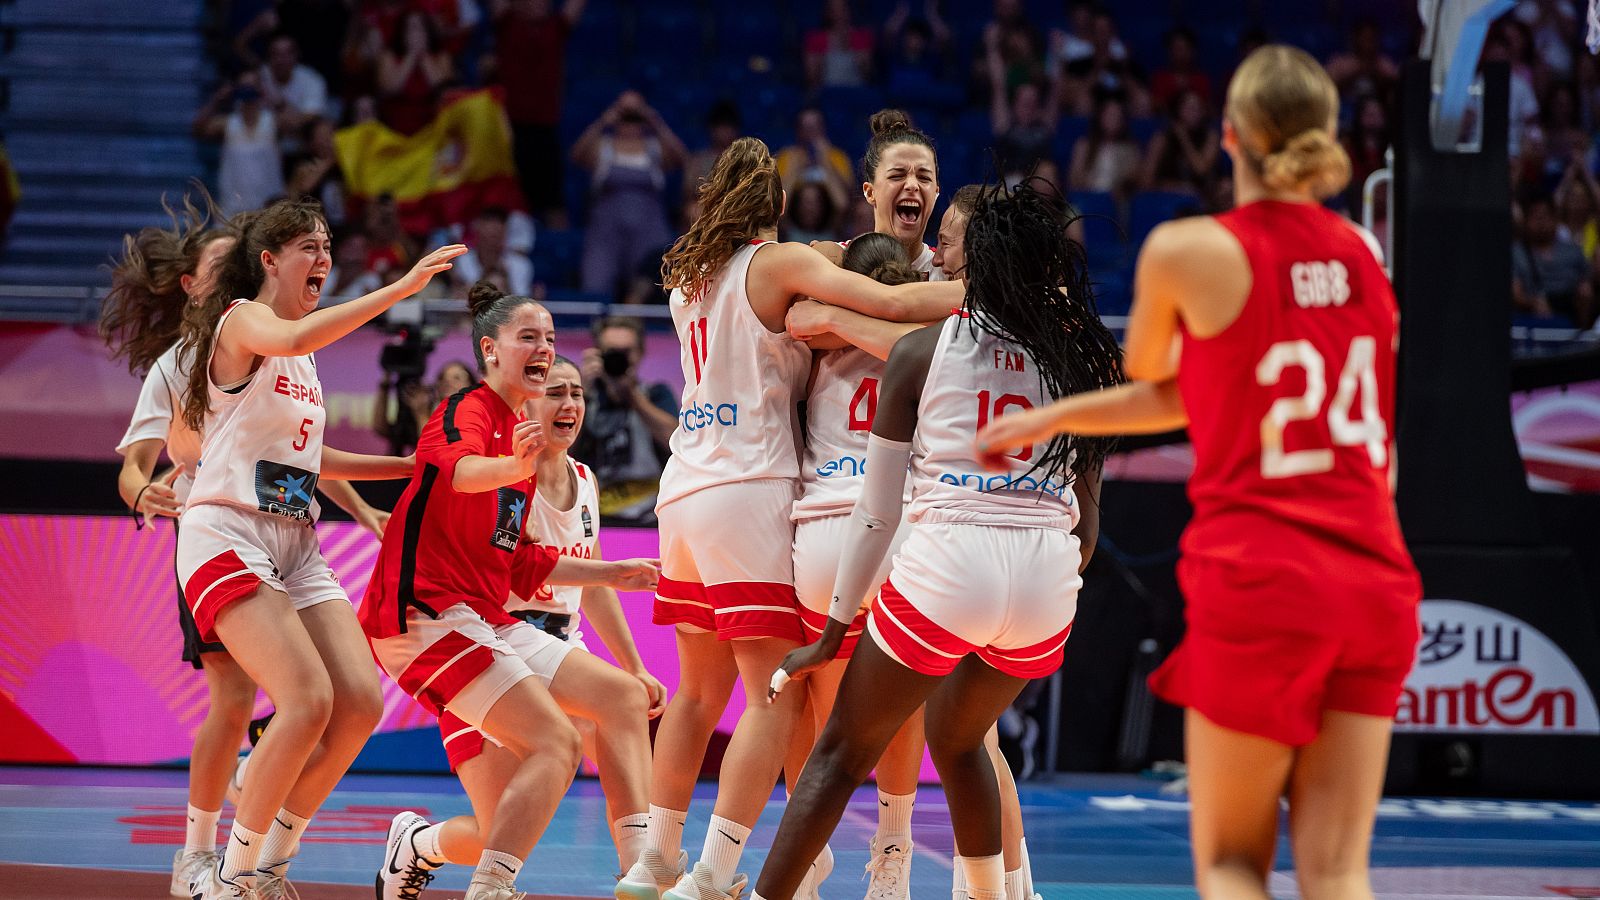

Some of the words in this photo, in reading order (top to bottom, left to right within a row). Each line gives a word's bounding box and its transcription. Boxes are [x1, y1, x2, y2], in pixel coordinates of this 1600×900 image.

[994, 349, 1025, 373] FAM
[848, 377, 879, 432] 4
[1255, 335, 1388, 479] 24
[292, 418, 313, 452] 5
